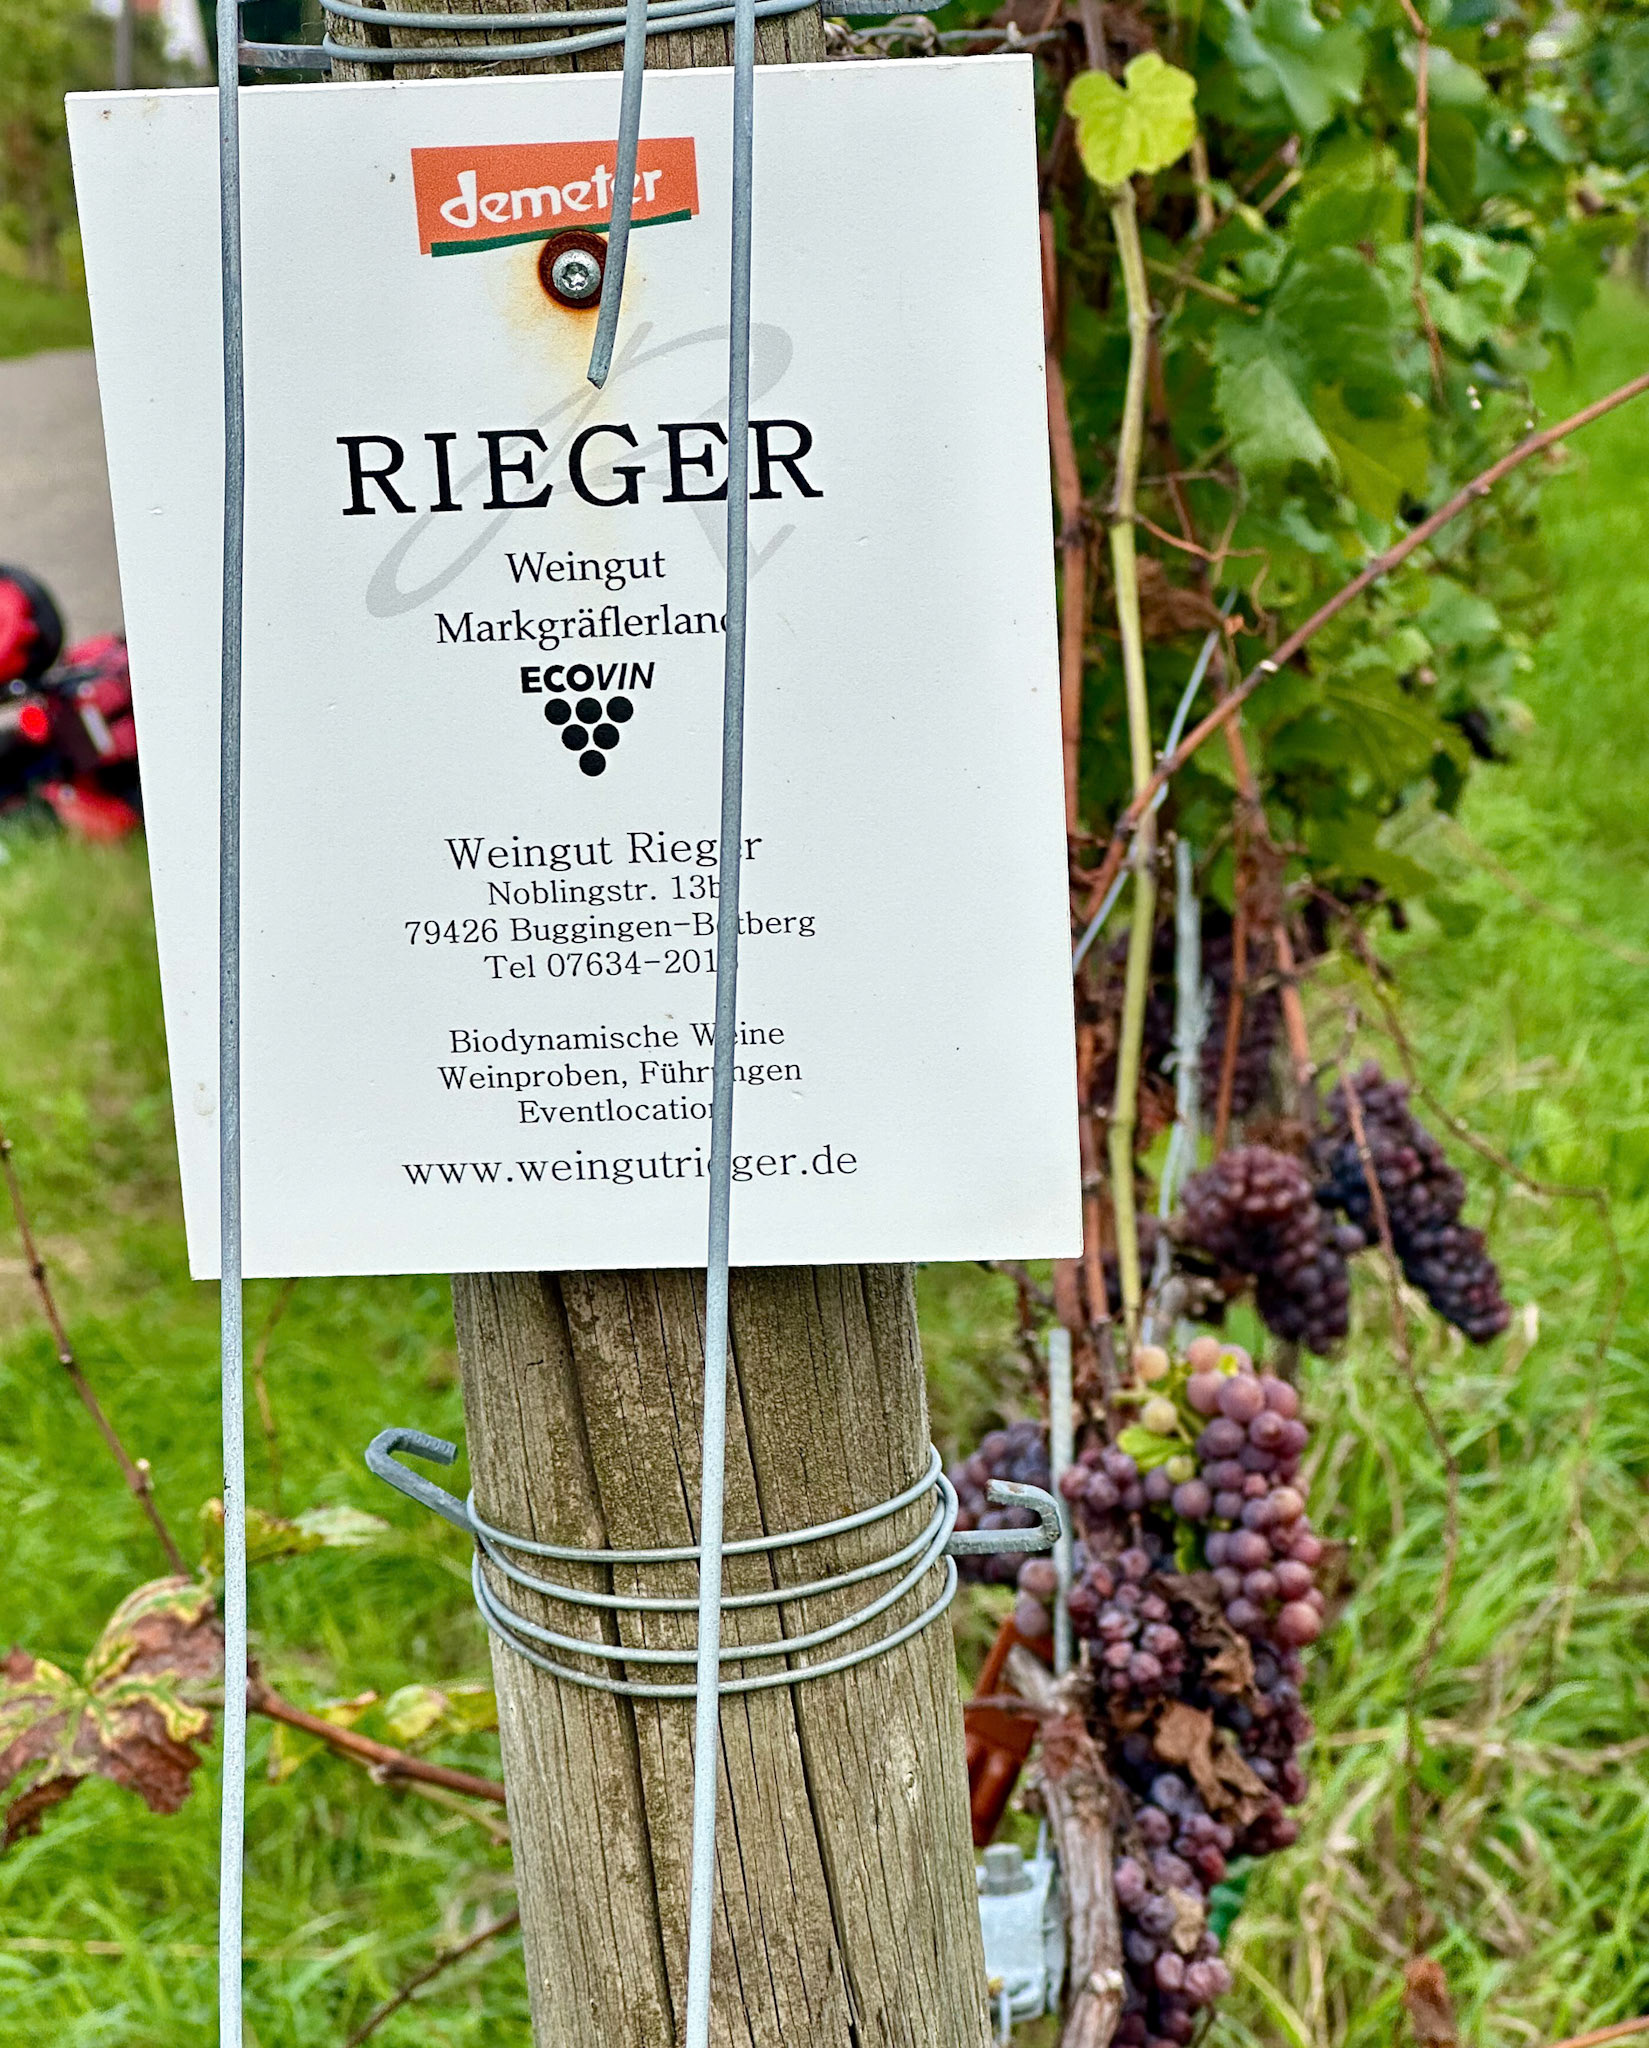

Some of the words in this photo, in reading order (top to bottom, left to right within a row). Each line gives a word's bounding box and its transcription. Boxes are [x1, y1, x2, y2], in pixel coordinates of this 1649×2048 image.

[336, 419, 824, 516] RIEGER
[504, 550, 666, 591] Weingut
[520, 661, 655, 694] ECOVIN
[444, 835, 613, 872] Weingut
[626, 831, 763, 867] Riegr
[488, 879, 656, 906] Noblingstr.
[405, 918, 498, 945] 79426
[509, 908, 816, 946] Buggingen-Btberg
[483, 954, 536, 979] Tel
[547, 948, 738, 978] 07634-201
[449, 1024, 679, 1055] Biodynamische
[689, 1021, 785, 1046] Wine
[437, 1063, 627, 1092] Weinproben,
[639, 1059, 802, 1087] Führngen
[517, 1096, 713, 1125] Eventlocatio
[401, 1145, 857, 1185] www.weingutriger.de
